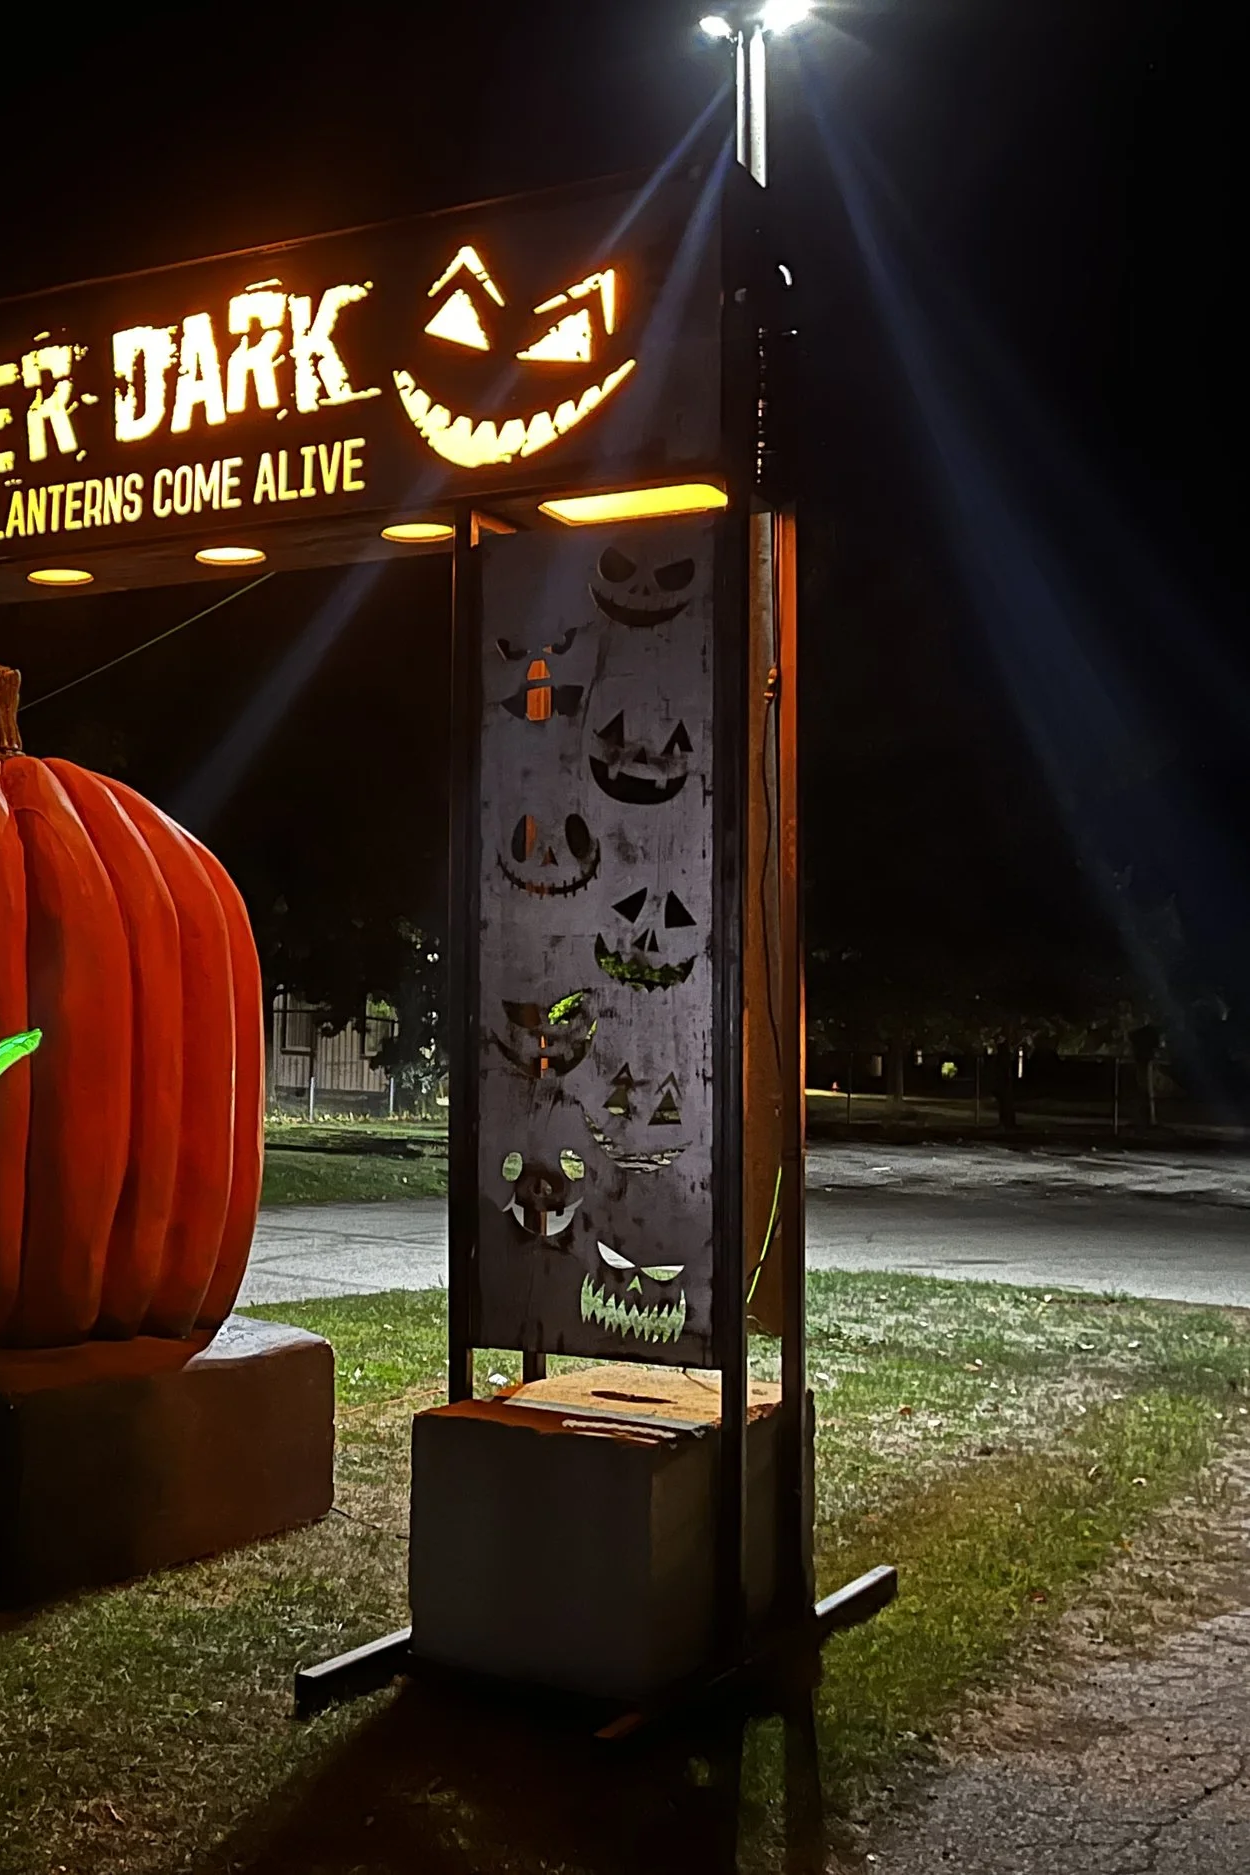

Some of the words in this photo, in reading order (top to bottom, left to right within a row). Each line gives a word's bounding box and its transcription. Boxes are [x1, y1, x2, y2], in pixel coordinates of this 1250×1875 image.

[112, 281, 382, 443] DARK
[152, 457, 244, 518] COME
[253, 437, 366, 505] ALIVE
